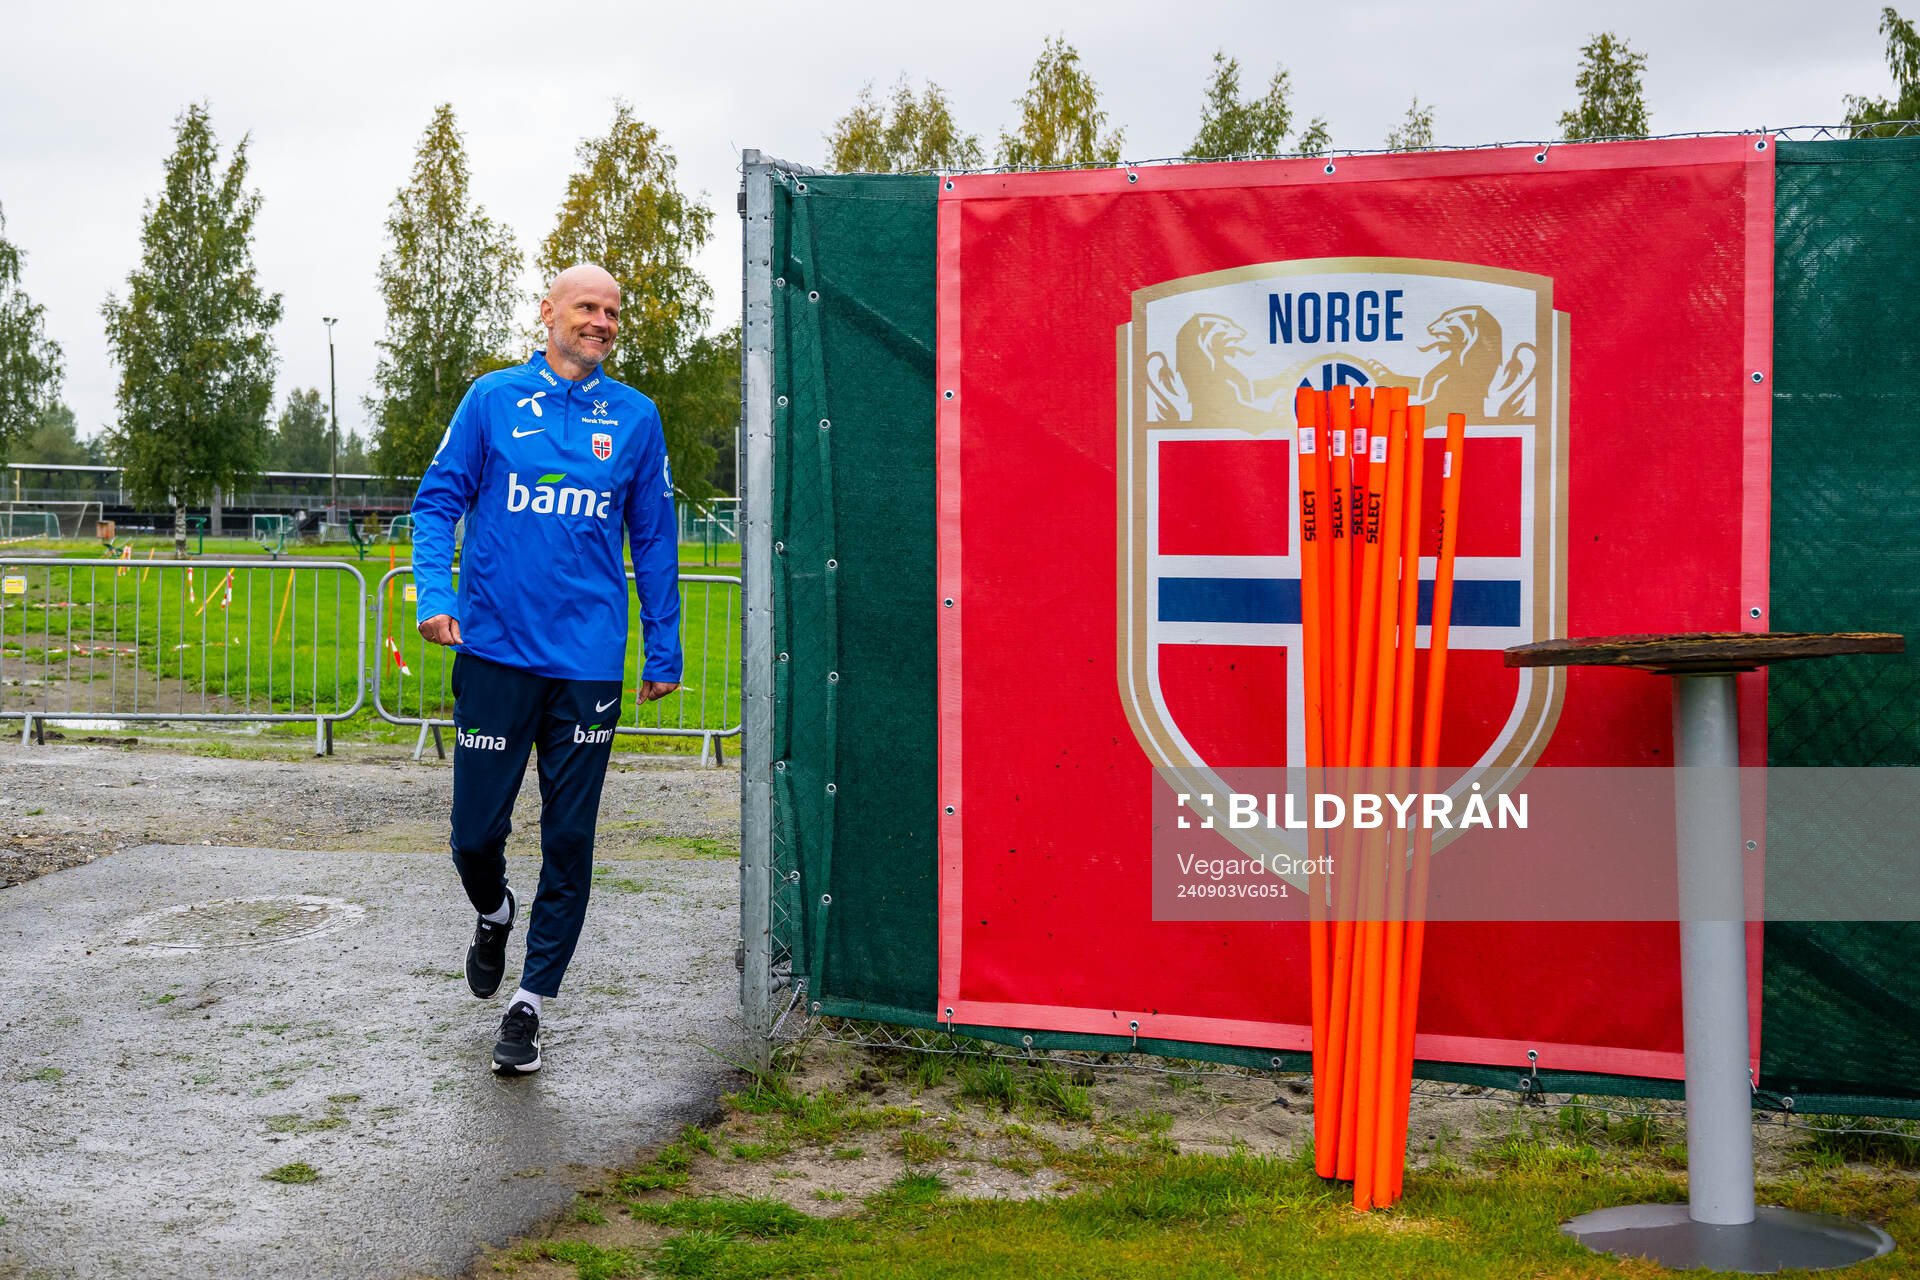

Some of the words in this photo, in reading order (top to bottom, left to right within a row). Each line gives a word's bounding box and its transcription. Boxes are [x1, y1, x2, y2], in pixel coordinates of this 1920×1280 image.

[1269, 290, 1404, 344] NORGE
[538, 368, 558, 387] bama
[582, 378, 600, 393] bama
[507, 472, 611, 519] bama
[1303, 490, 1316, 542] SELECT
[1366, 491, 1381, 544] SELECT
[457, 726, 507, 751] bama
[573, 724, 612, 744] bam
